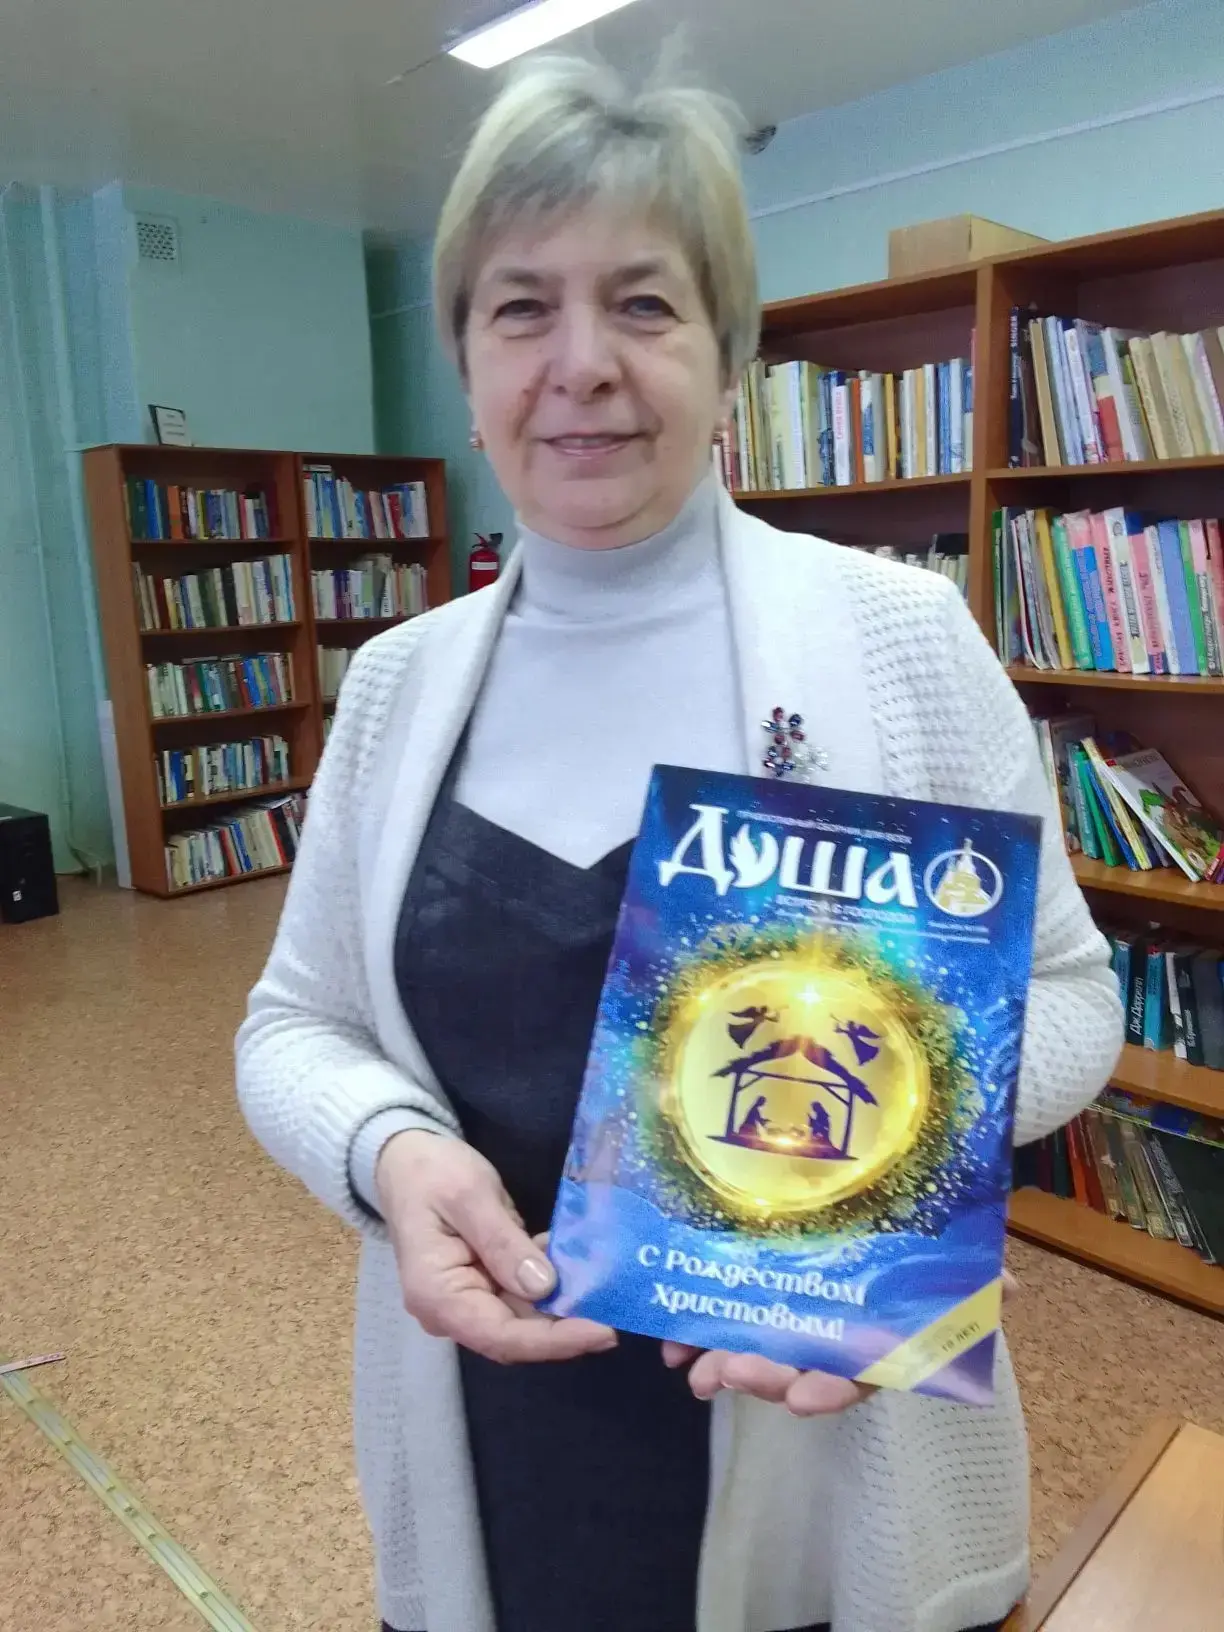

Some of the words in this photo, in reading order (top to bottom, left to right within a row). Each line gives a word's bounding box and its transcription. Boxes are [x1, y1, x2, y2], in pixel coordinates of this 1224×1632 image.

[658, 803, 918, 908] Душа
[665, 1249, 867, 1307] Рождеством
[650, 1281, 845, 1341] Христовым!
